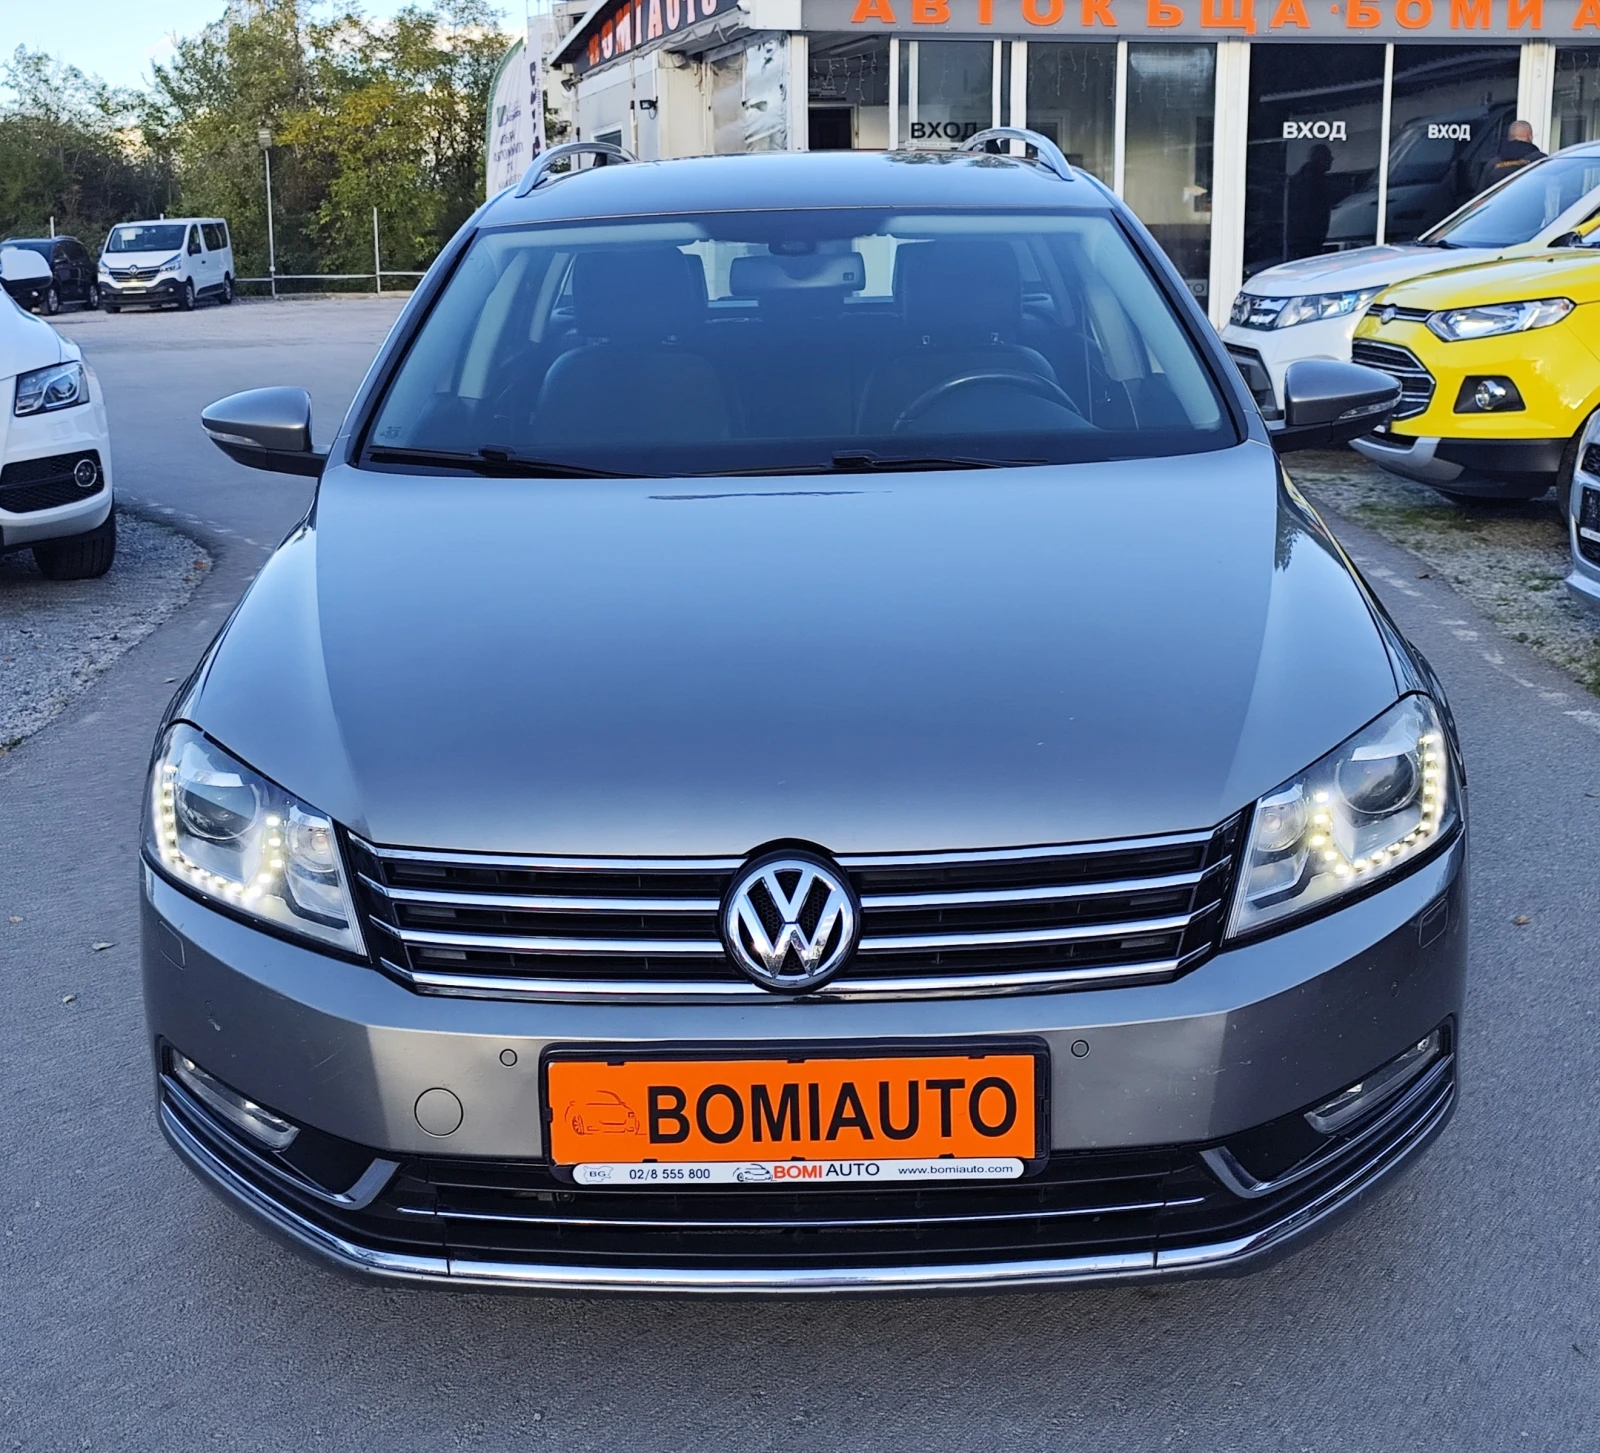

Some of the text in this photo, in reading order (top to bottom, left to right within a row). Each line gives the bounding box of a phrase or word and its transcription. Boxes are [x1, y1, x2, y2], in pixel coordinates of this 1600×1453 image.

[586, 0, 718, 67] BOMIAU
[910, 121, 978, 142] ВХОД
[1282, 120, 1347, 142] ВХОД
[1427, 123, 1471, 142] ВХОД
[648, 1076, 1018, 1145] BOMIAUTO
[589, 1170, 606, 1178] BG
[629, 1168, 711, 1181] 02/8 555 800
[773, 1163, 880, 1179] BOMI AUTO
[897, 1164, 1014, 1176] www.bomiauto.com
